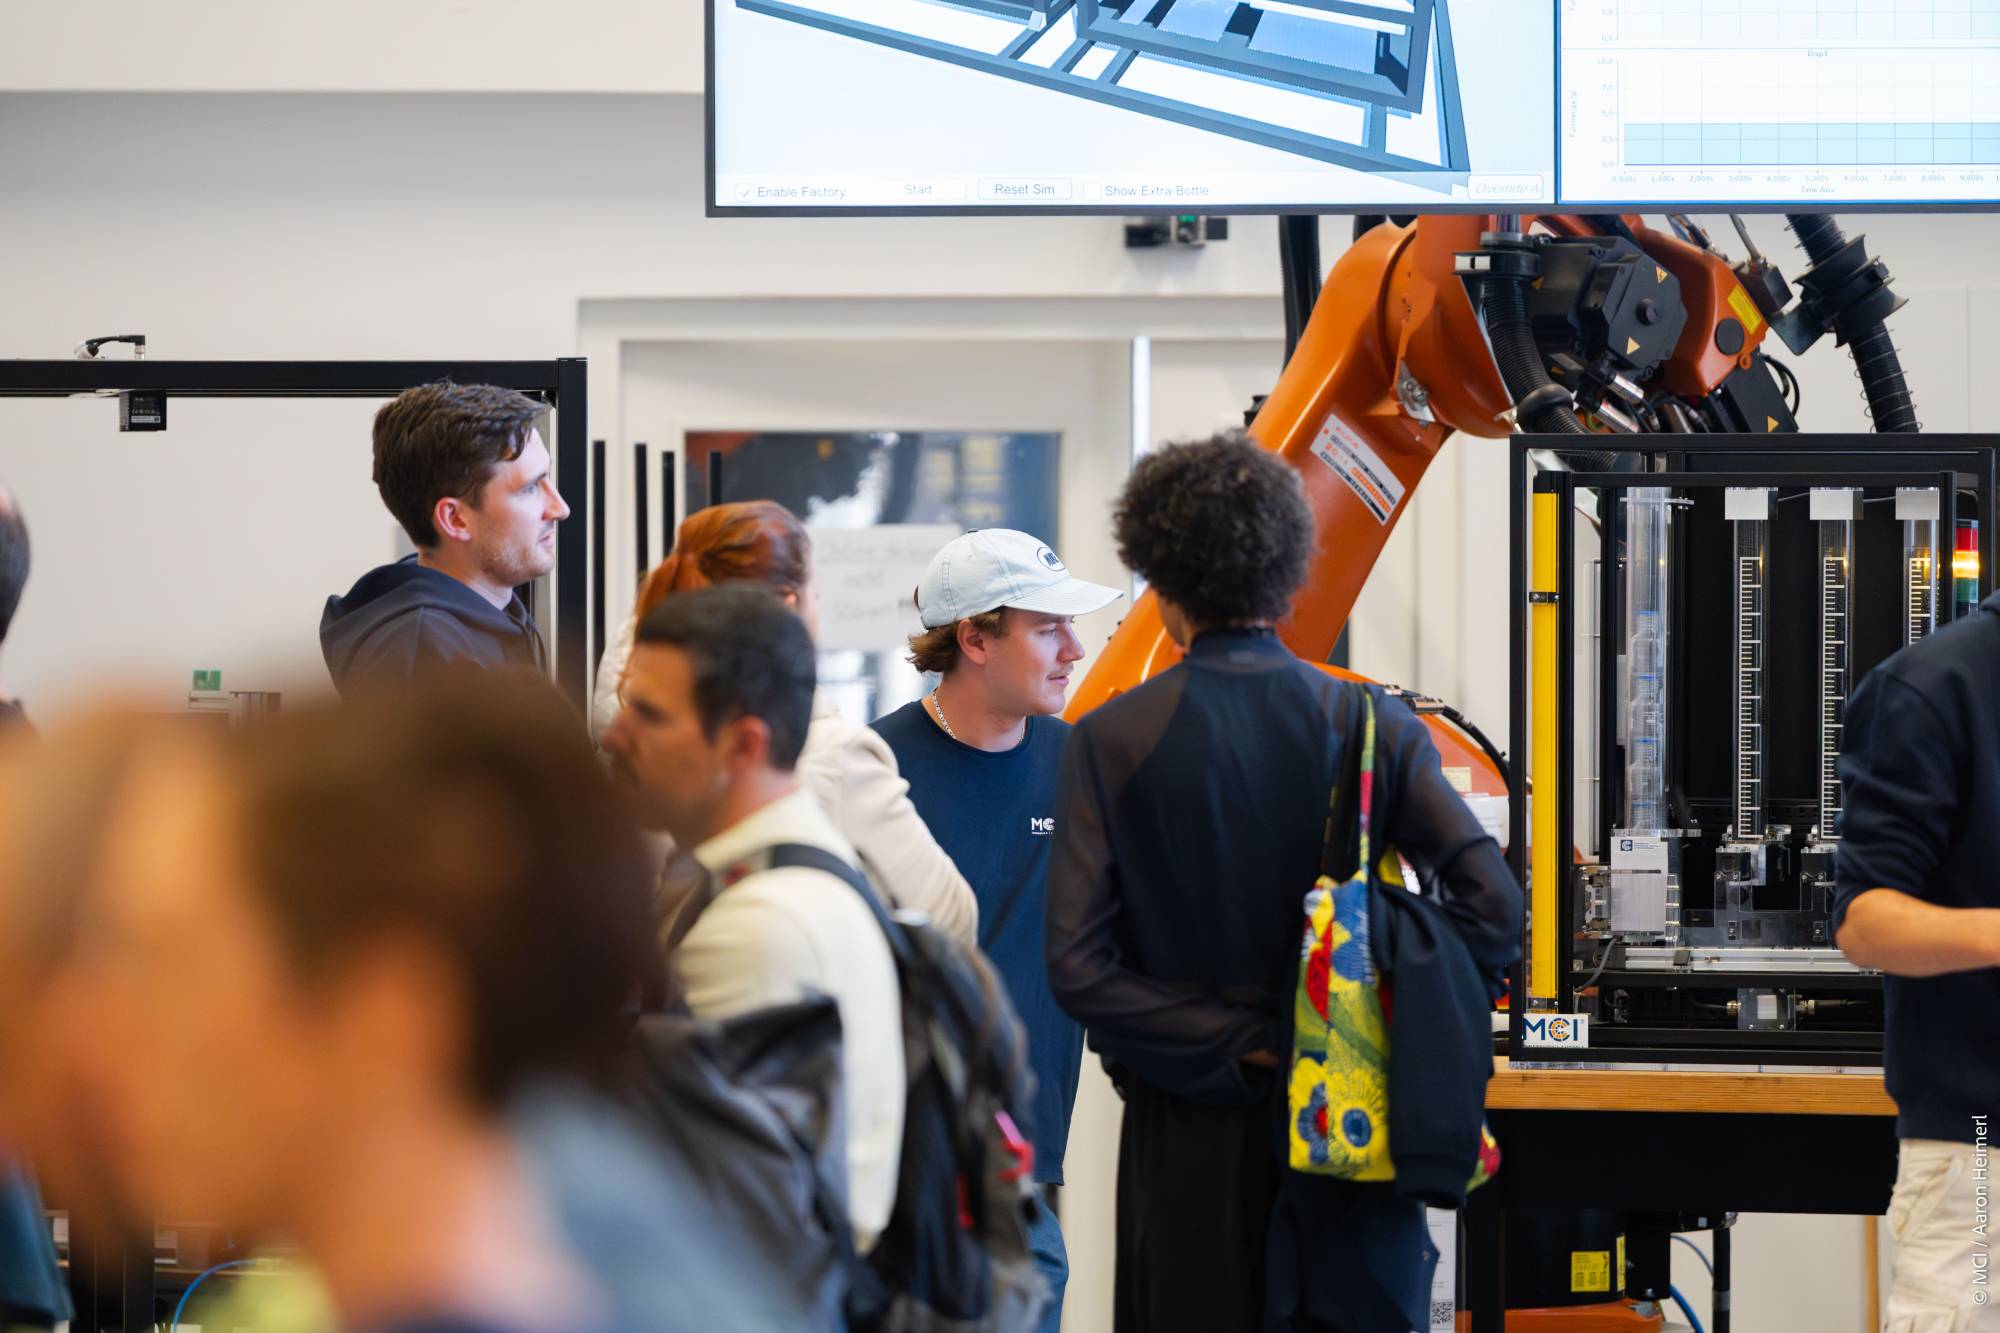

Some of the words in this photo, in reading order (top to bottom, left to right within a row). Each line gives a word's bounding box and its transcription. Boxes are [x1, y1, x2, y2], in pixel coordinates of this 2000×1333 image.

[757, 186, 798, 198] Enable
[801, 186, 847, 200] Factory
[904, 184, 933, 196] Start
[994, 184, 1029, 195] Reset
[1033, 184, 1055, 195] Sim
[1104, 185, 1137, 197] Show
[1141, 185, 1172, 197] Extra
[1176, 185, 1209, 197] Bottle
[1031, 817, 1055, 831] MC
[1522, 1018, 1578, 1041] MCI
